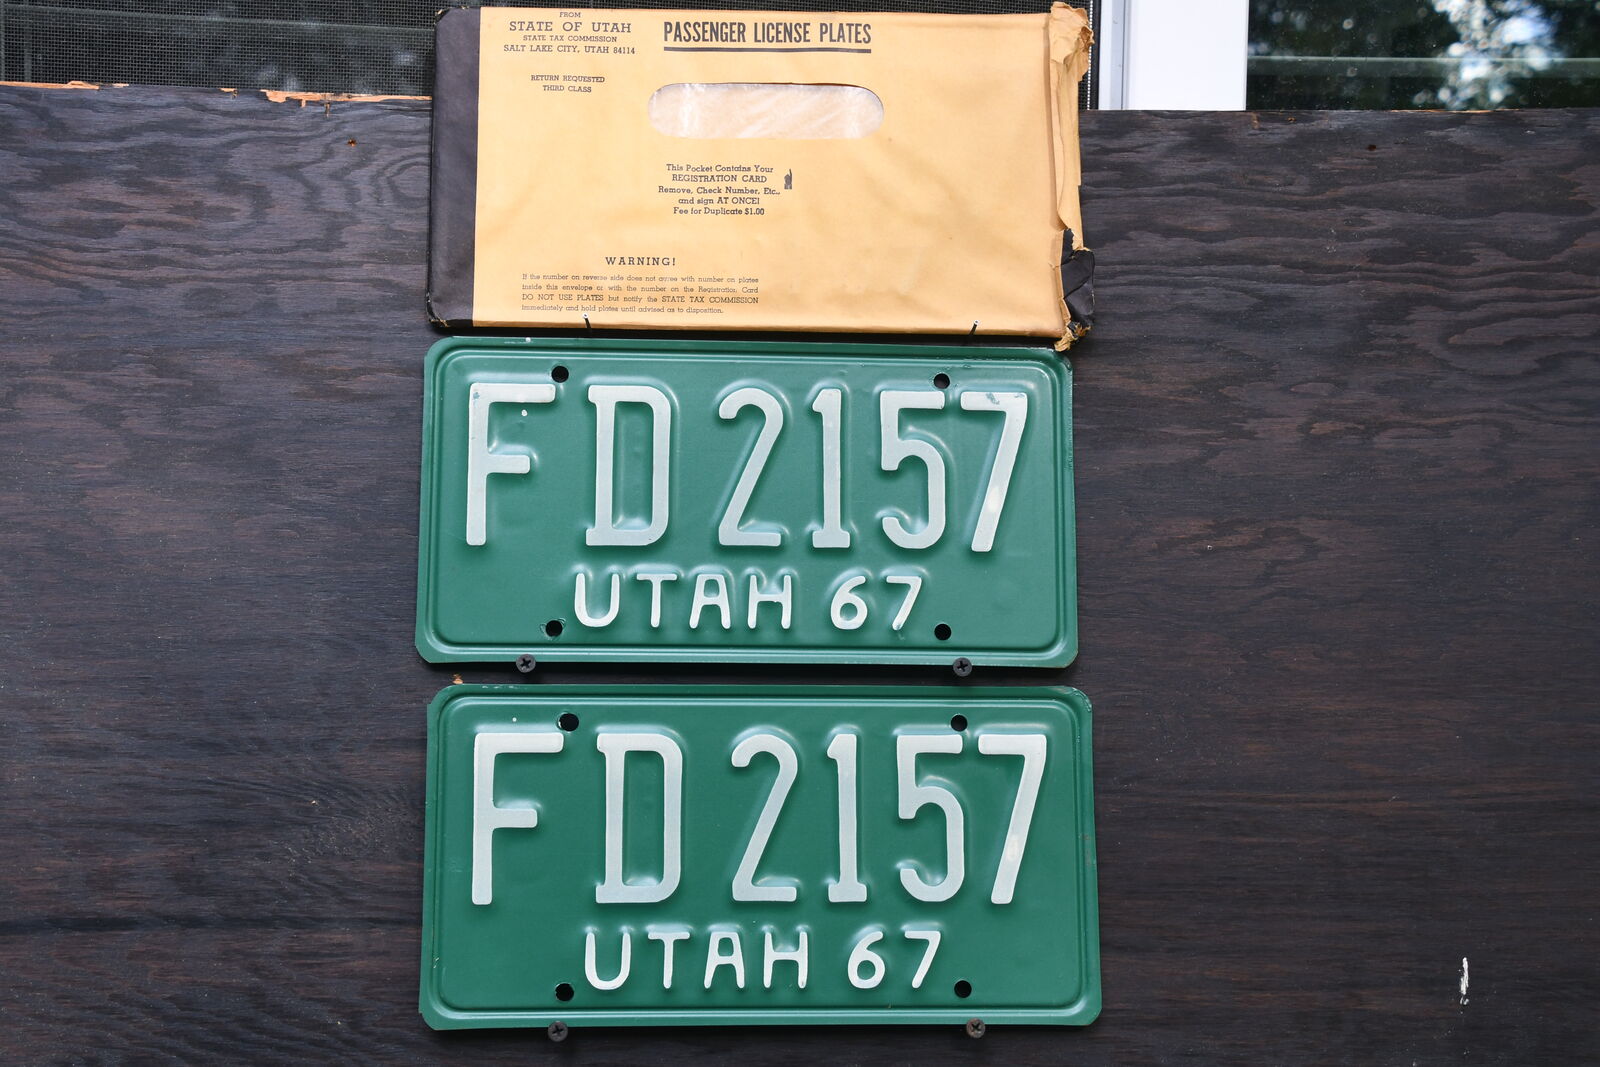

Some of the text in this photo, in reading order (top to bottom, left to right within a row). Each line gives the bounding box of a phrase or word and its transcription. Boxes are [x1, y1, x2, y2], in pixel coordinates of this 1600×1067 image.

[509, 21, 631, 32] STATE OF UTAH
[664, 22, 871, 44] PASSENGER LICENSE PLATES
[659, 186, 693, 195] Remove,
[697, 197, 713, 205] sign
[704, 207, 742, 215] Duplicate
[606, 257, 676, 266] WARNING!
[574, 572, 922, 631] UTAH 67
[585, 930, 940, 989] UTAH 67
